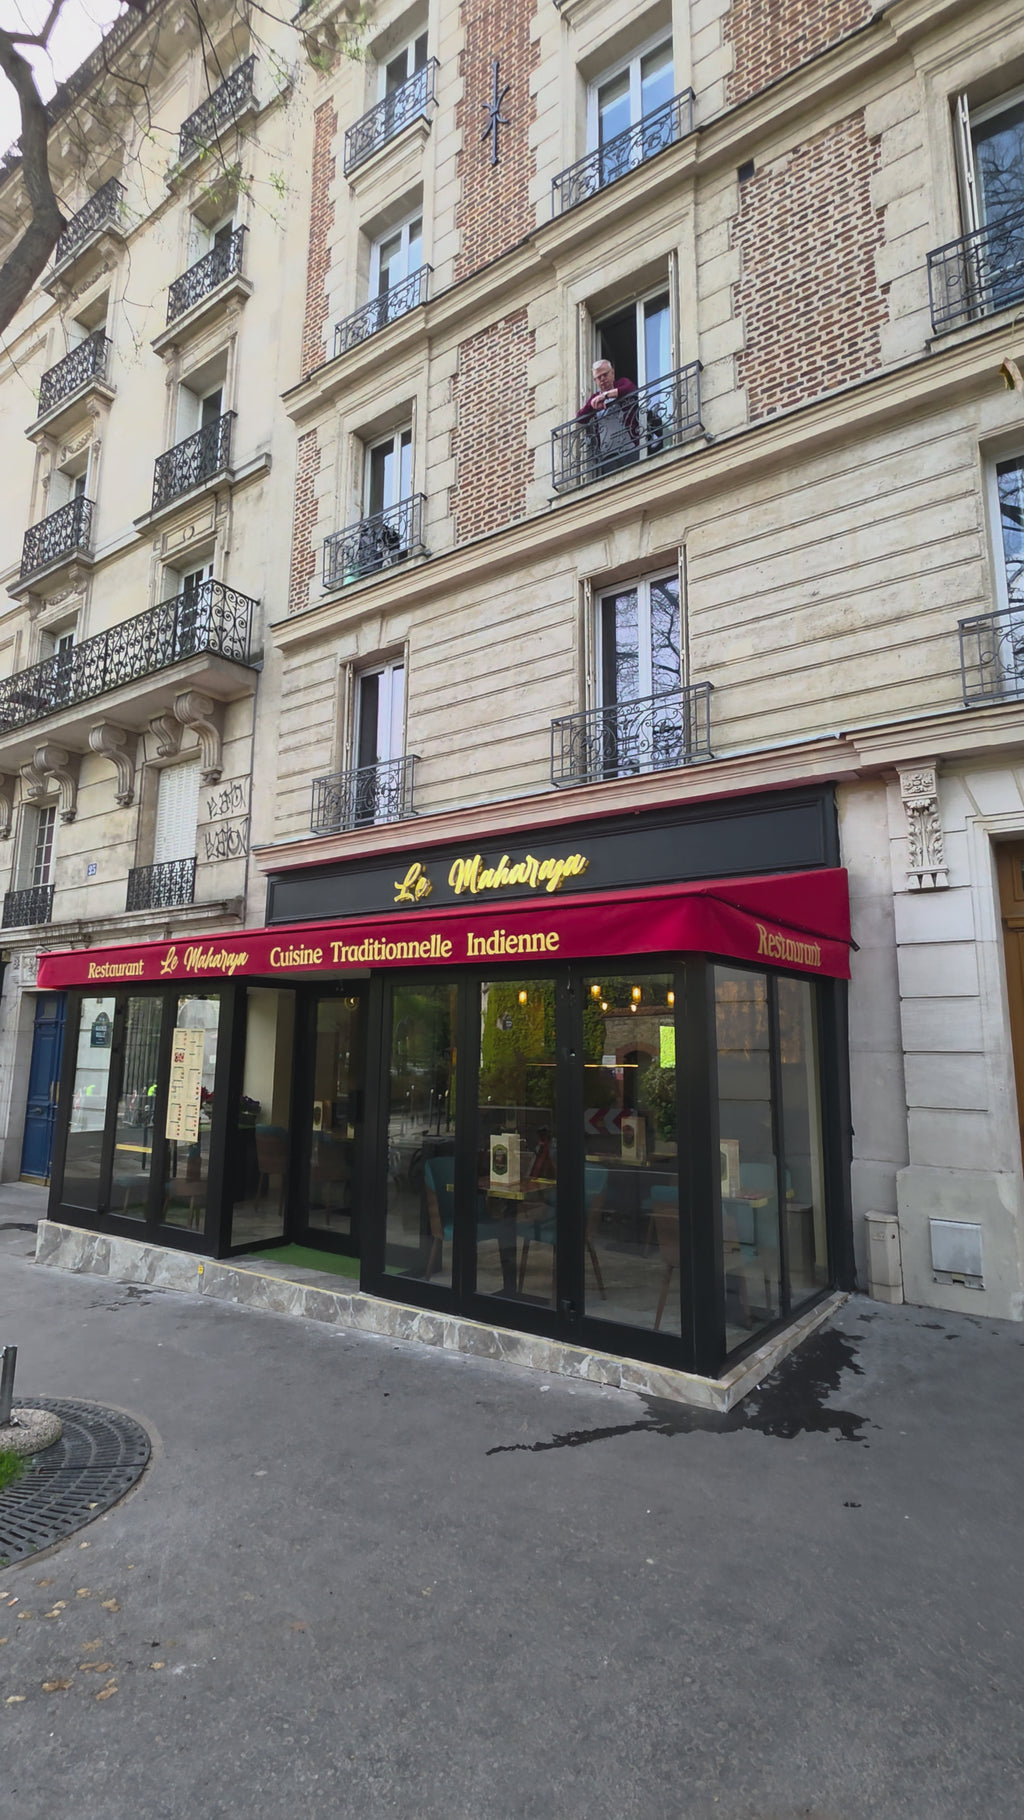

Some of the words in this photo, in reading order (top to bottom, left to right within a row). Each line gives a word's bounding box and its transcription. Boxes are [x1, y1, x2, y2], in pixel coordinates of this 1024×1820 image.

[393, 862, 432, 902] Le
[87, 960, 145, 979] Restaurant
[160, 946, 179, 975] Le
[270, 944, 323, 967] Cuisine
[330, 934, 453, 962] Traditionnelle
[466, 929, 560, 956] Indienne
[755, 922, 822, 967] Restaurant
